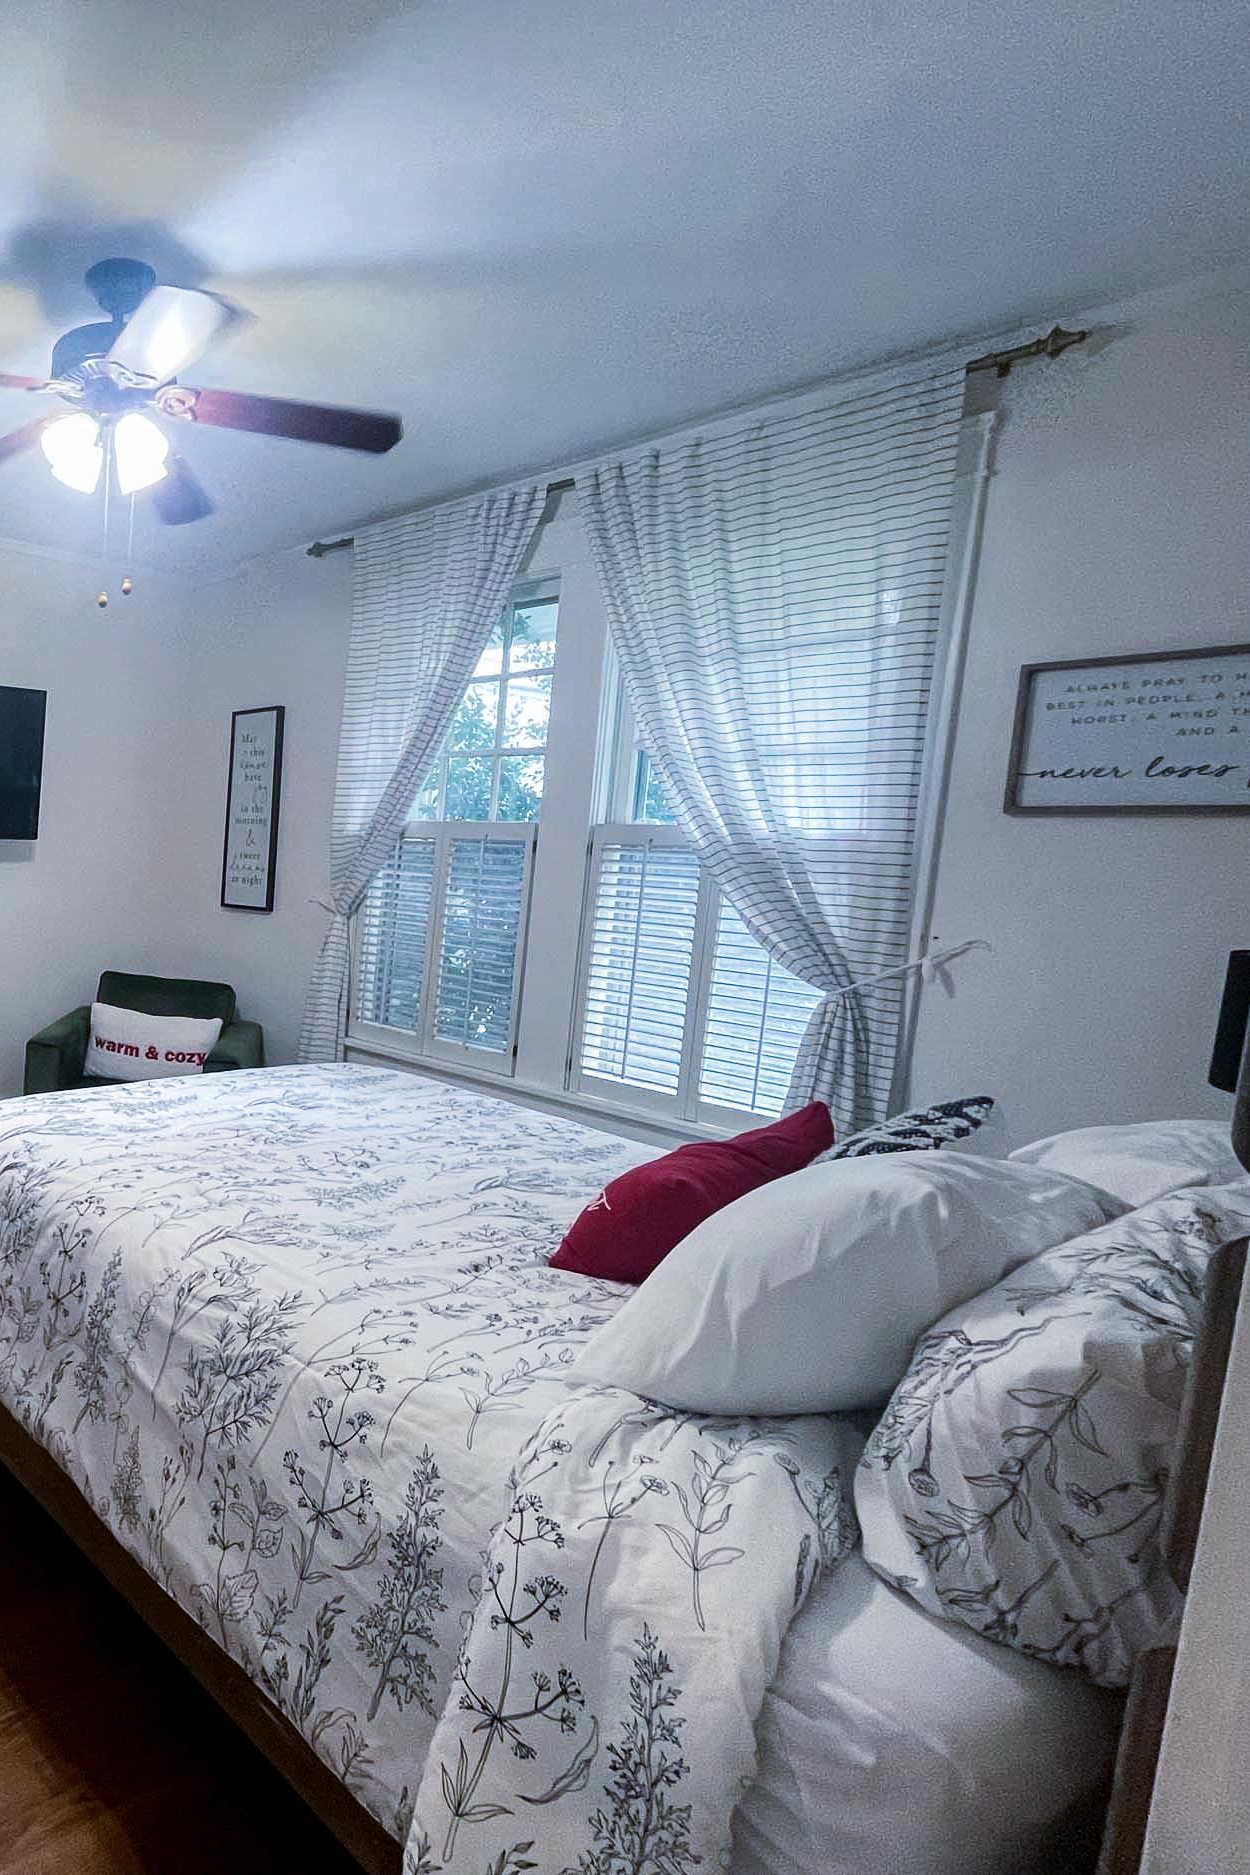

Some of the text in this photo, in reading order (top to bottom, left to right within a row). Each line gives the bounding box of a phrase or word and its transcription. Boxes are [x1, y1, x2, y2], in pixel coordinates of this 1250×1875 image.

[1064, 680, 1131, 694] ALWAYS
[1141, 676, 1184, 688] PRAY
[1200, 673, 1223, 685] TO
[1046, 700, 1087, 711] BEST
[1096, 698, 1114, 707] IN
[1215, 690, 1227, 700] A
[1146, 711, 1157, 721] A
[1169, 709, 1218, 719] MIND
[1175, 725, 1239, 737] AND A
[1020, 755, 1240, 779] never loses
[94, 1036, 207, 1066] warm & cozy
